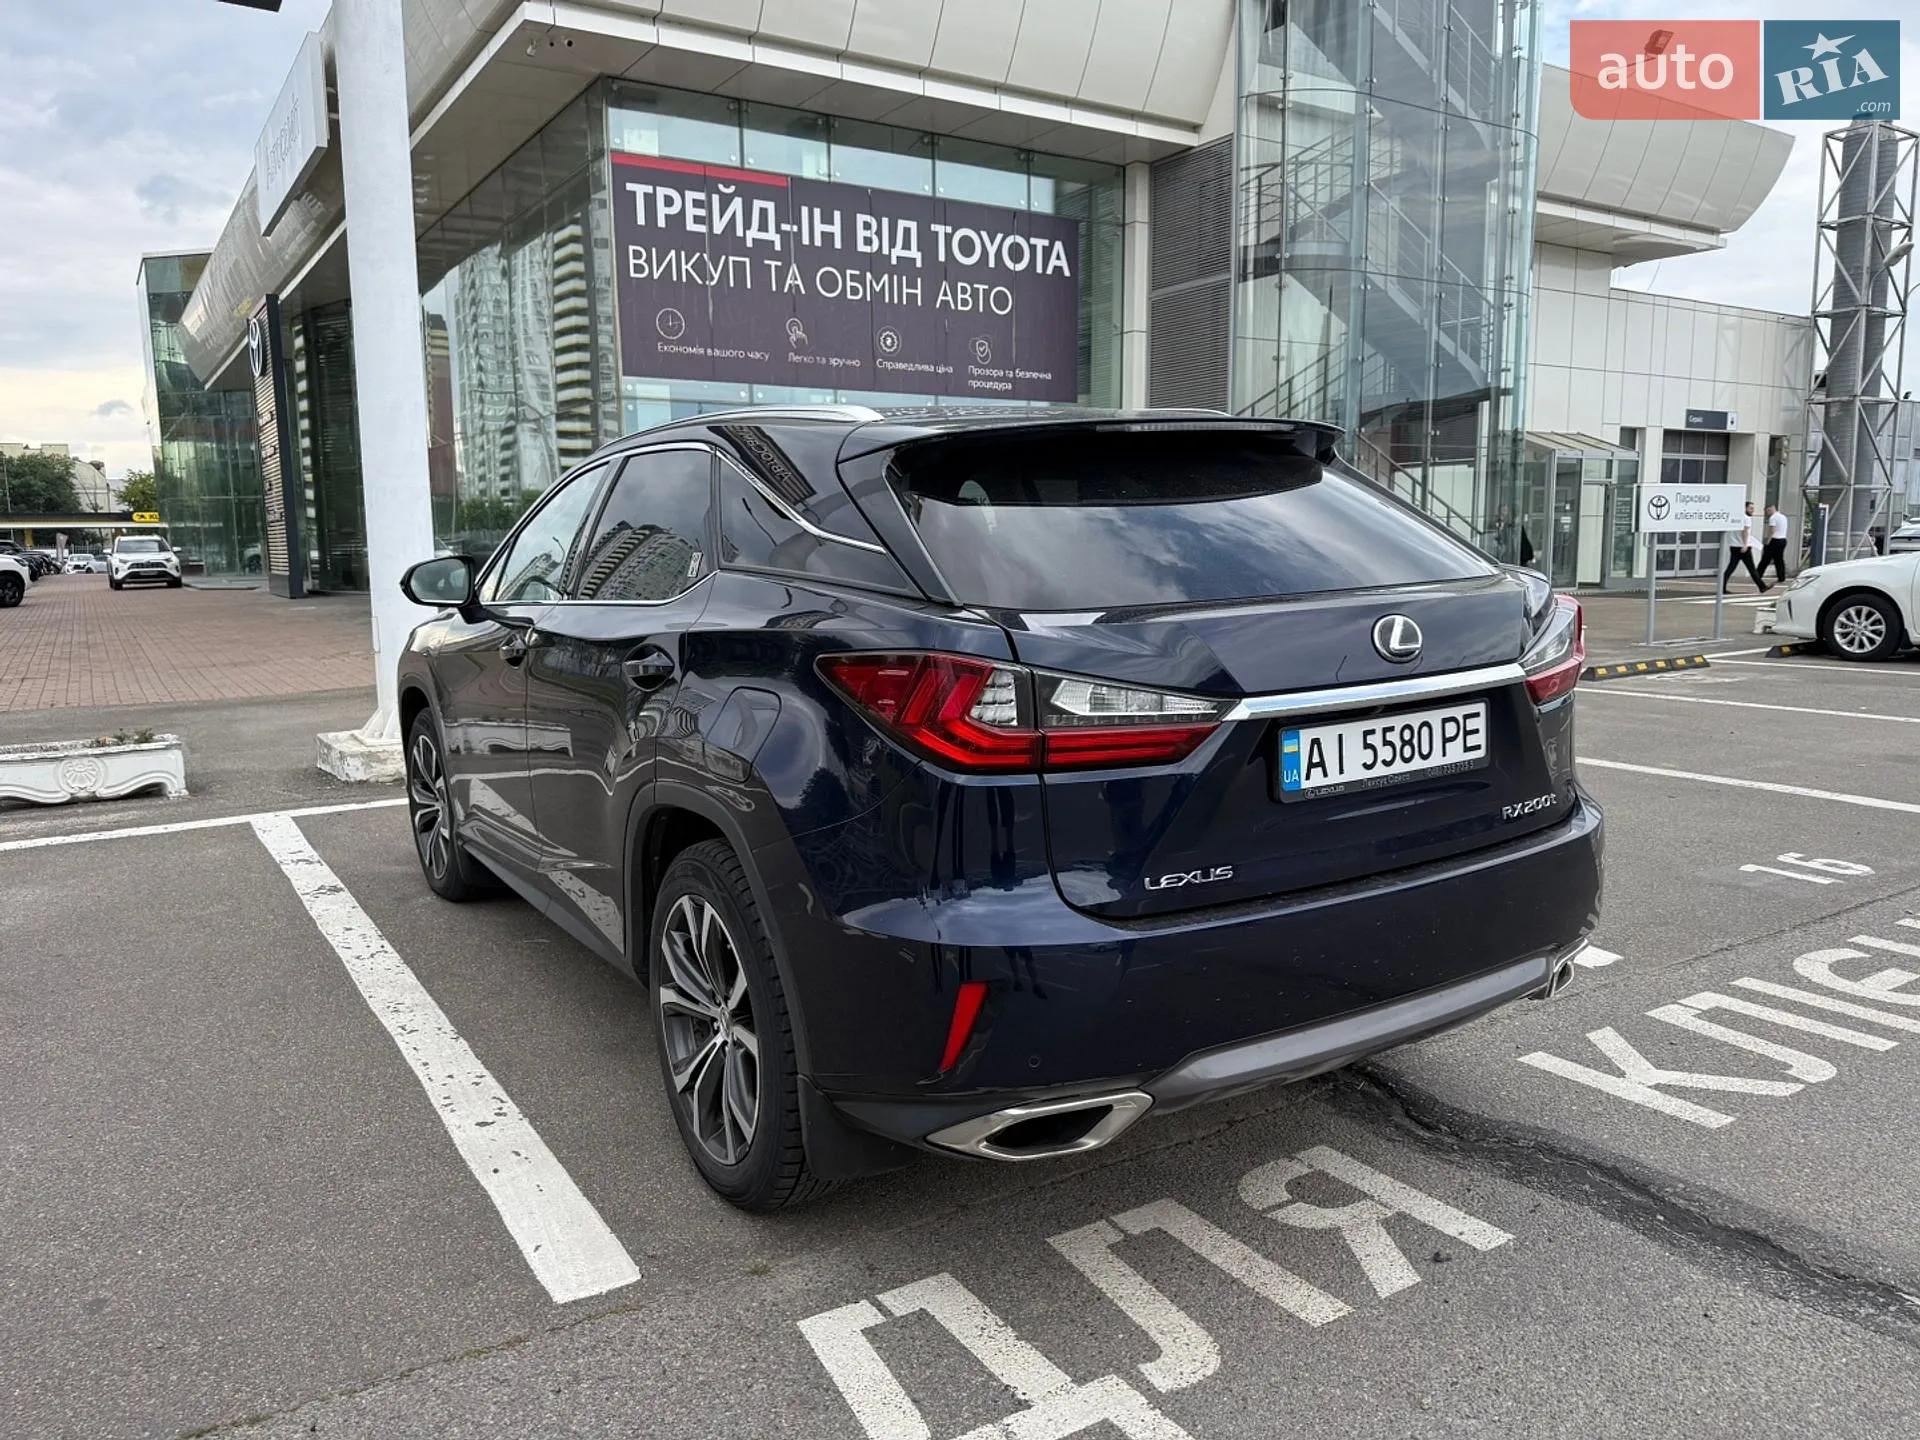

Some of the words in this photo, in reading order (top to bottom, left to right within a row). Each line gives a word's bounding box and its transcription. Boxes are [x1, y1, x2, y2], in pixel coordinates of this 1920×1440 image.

[625, 182, 842, 251] ТРЕЙД-ІН
[856, 213, 922, 268] ВІД
[931, 223, 1071, 277] TOYOTA
[628, 245, 751, 289] ВИКУП
[764, 259, 806, 295] ТА
[816, 266, 922, 307] ОБМІН
[936, 281, 1013, 315] АВТО
[657, 342, 705, 355] Економія
[707, 349, 745, 360] вашого
[748, 351, 770, 362] часу
[787, 352, 814, 364] Легко
[816, 356, 826, 365] та
[828, 357, 861, 368] зручно
[876, 358, 935, 373] Справедлива
[936, 362, 953, 374] ціна
[968, 365, 1004, 378] Прозора
[1005, 368, 1014, 378] та
[1015, 368, 1052, 380] безпечна
[968, 379, 1013, 391] процедура
[1675, 492, 1711, 504] Парковка
[1704, 509, 1730, 522] сервісу
[1305, 733, 1345, 780] AI
[1362, 720, 1434, 771] 5580
[1284, 769, 1299, 784] UA
[1144, 865, 1234, 890] LEXUS
[796, 1144, 1517, 1440] ДЛЯ
